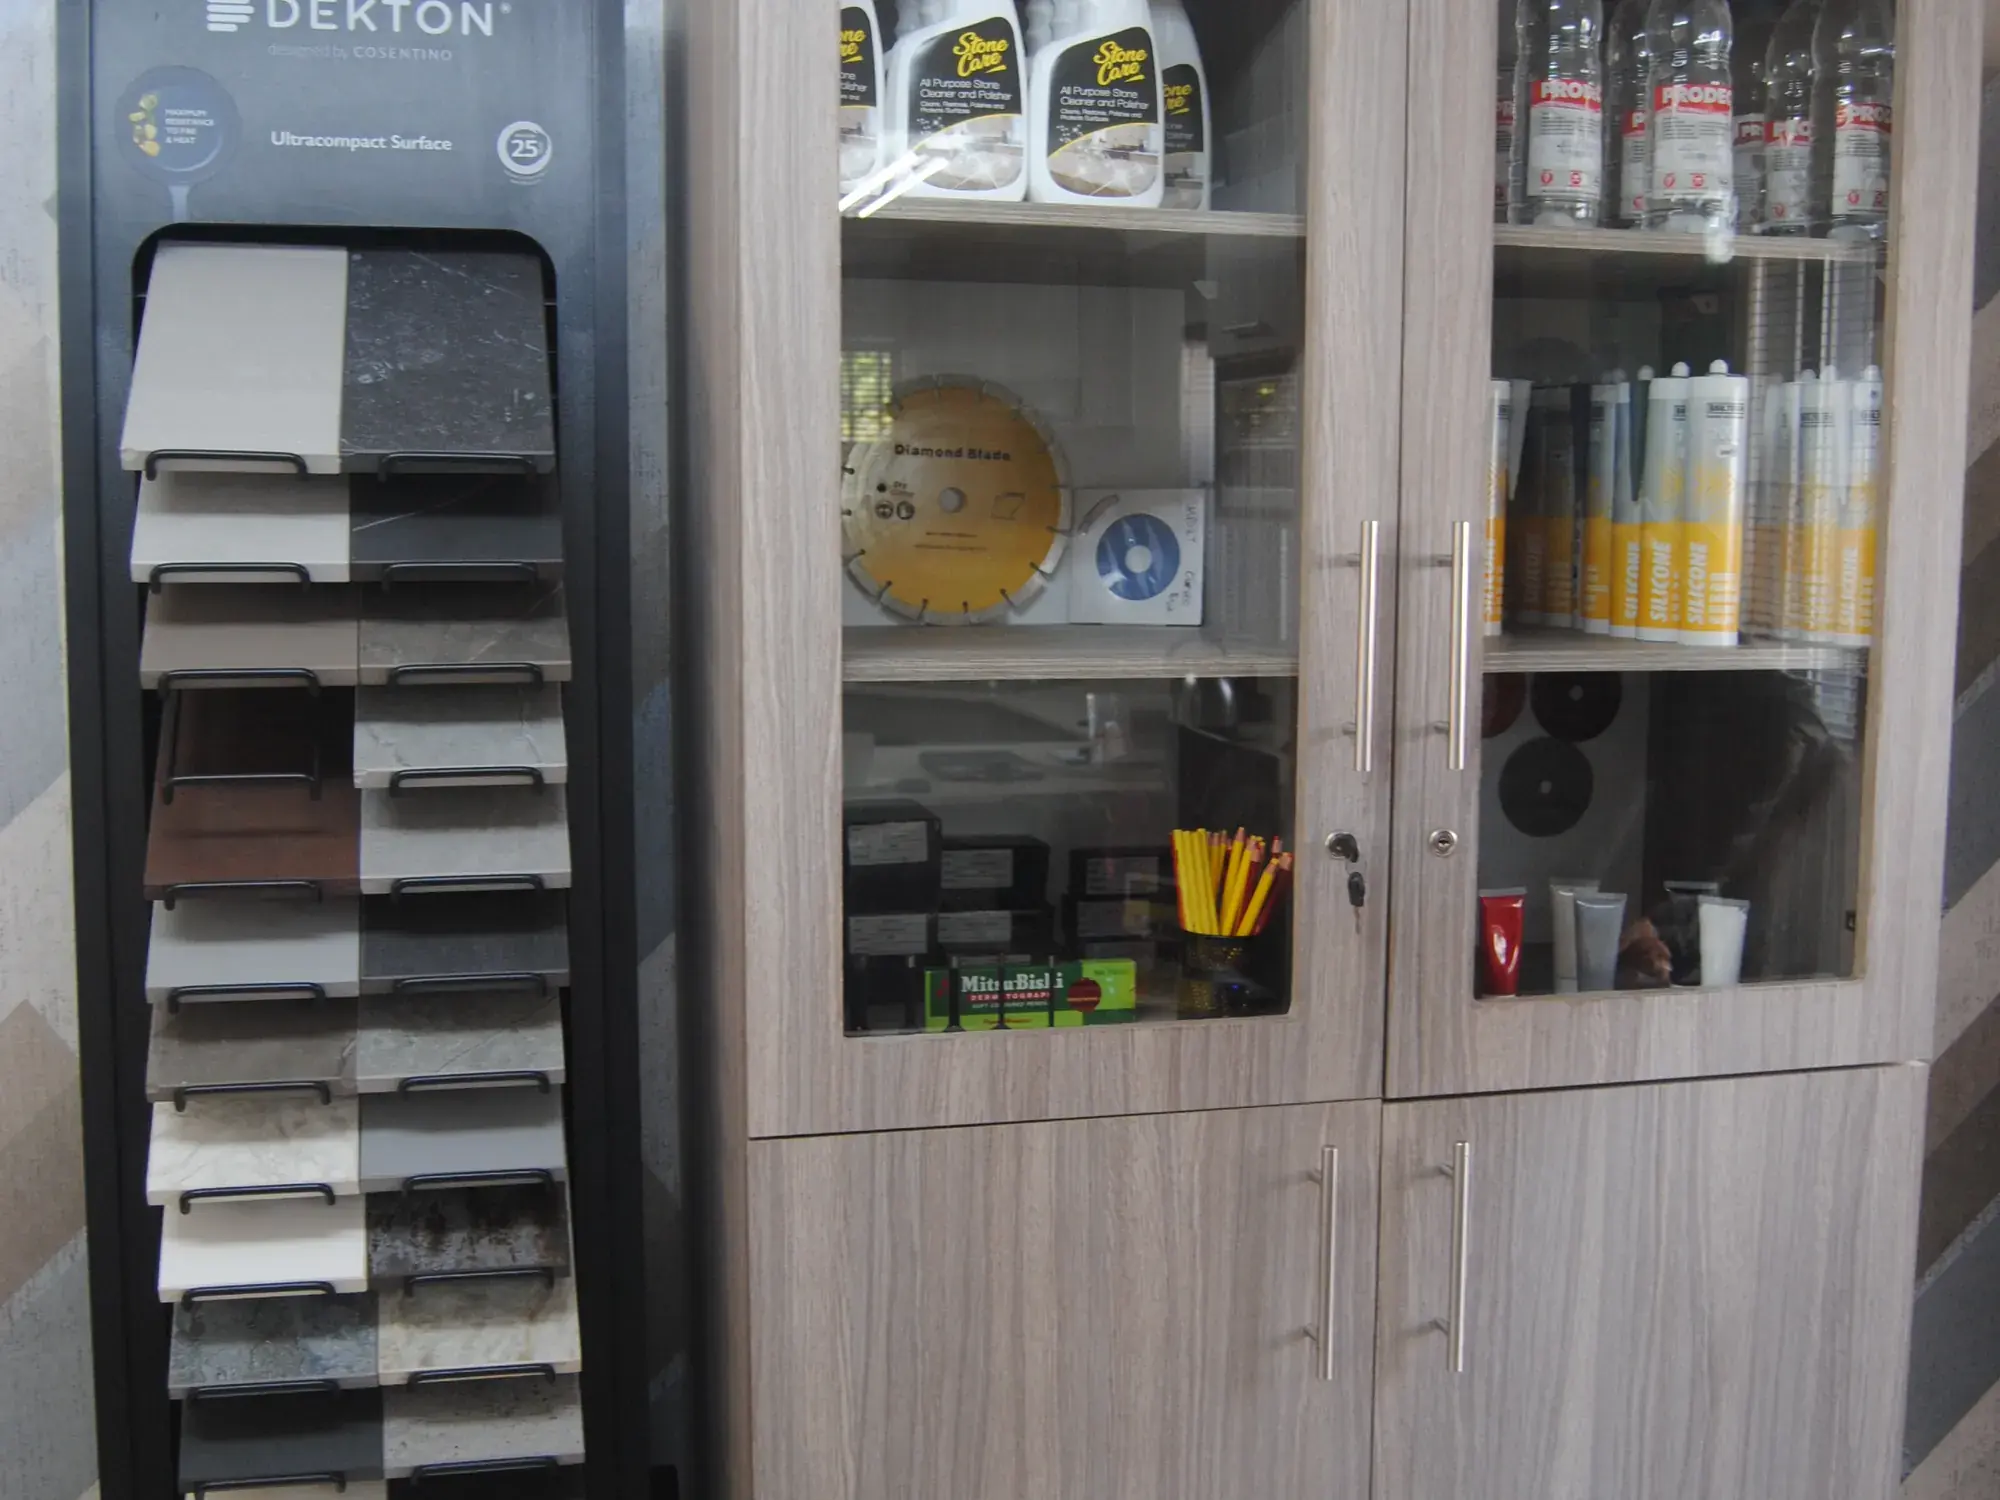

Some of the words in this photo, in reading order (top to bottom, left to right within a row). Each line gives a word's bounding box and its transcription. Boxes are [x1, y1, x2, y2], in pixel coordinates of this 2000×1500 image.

[267, 0, 494, 36] DEKTON
[952, 31, 1009, 55] Stone
[1093, 41, 1148, 64] Stone
[354, 46, 453, 61] COSENTINO
[957, 52, 1002, 77] Care
[1097, 61, 1140, 85] Care
[920, 89, 956, 98] Cleaner
[957, 90, 977, 99] and
[933, 78, 972, 89] Purpose
[973, 80, 1000, 90] Stone
[1073, 86, 1111, 97] Purpose
[1112, 88, 1138, 98] Stone
[1060, 96, 1096, 106] Cleaner
[1097, 98, 1116, 107] and
[270, 131, 387, 151] Ultracompact
[390, 135, 453, 150] Surface
[510, 140, 538, 157] 25
[894, 444, 963, 458] Diamond
[967, 448, 1011, 461] Blade
[1650, 540, 1671, 623] SILICONE
[1687, 541, 1708, 625] SILICONE
